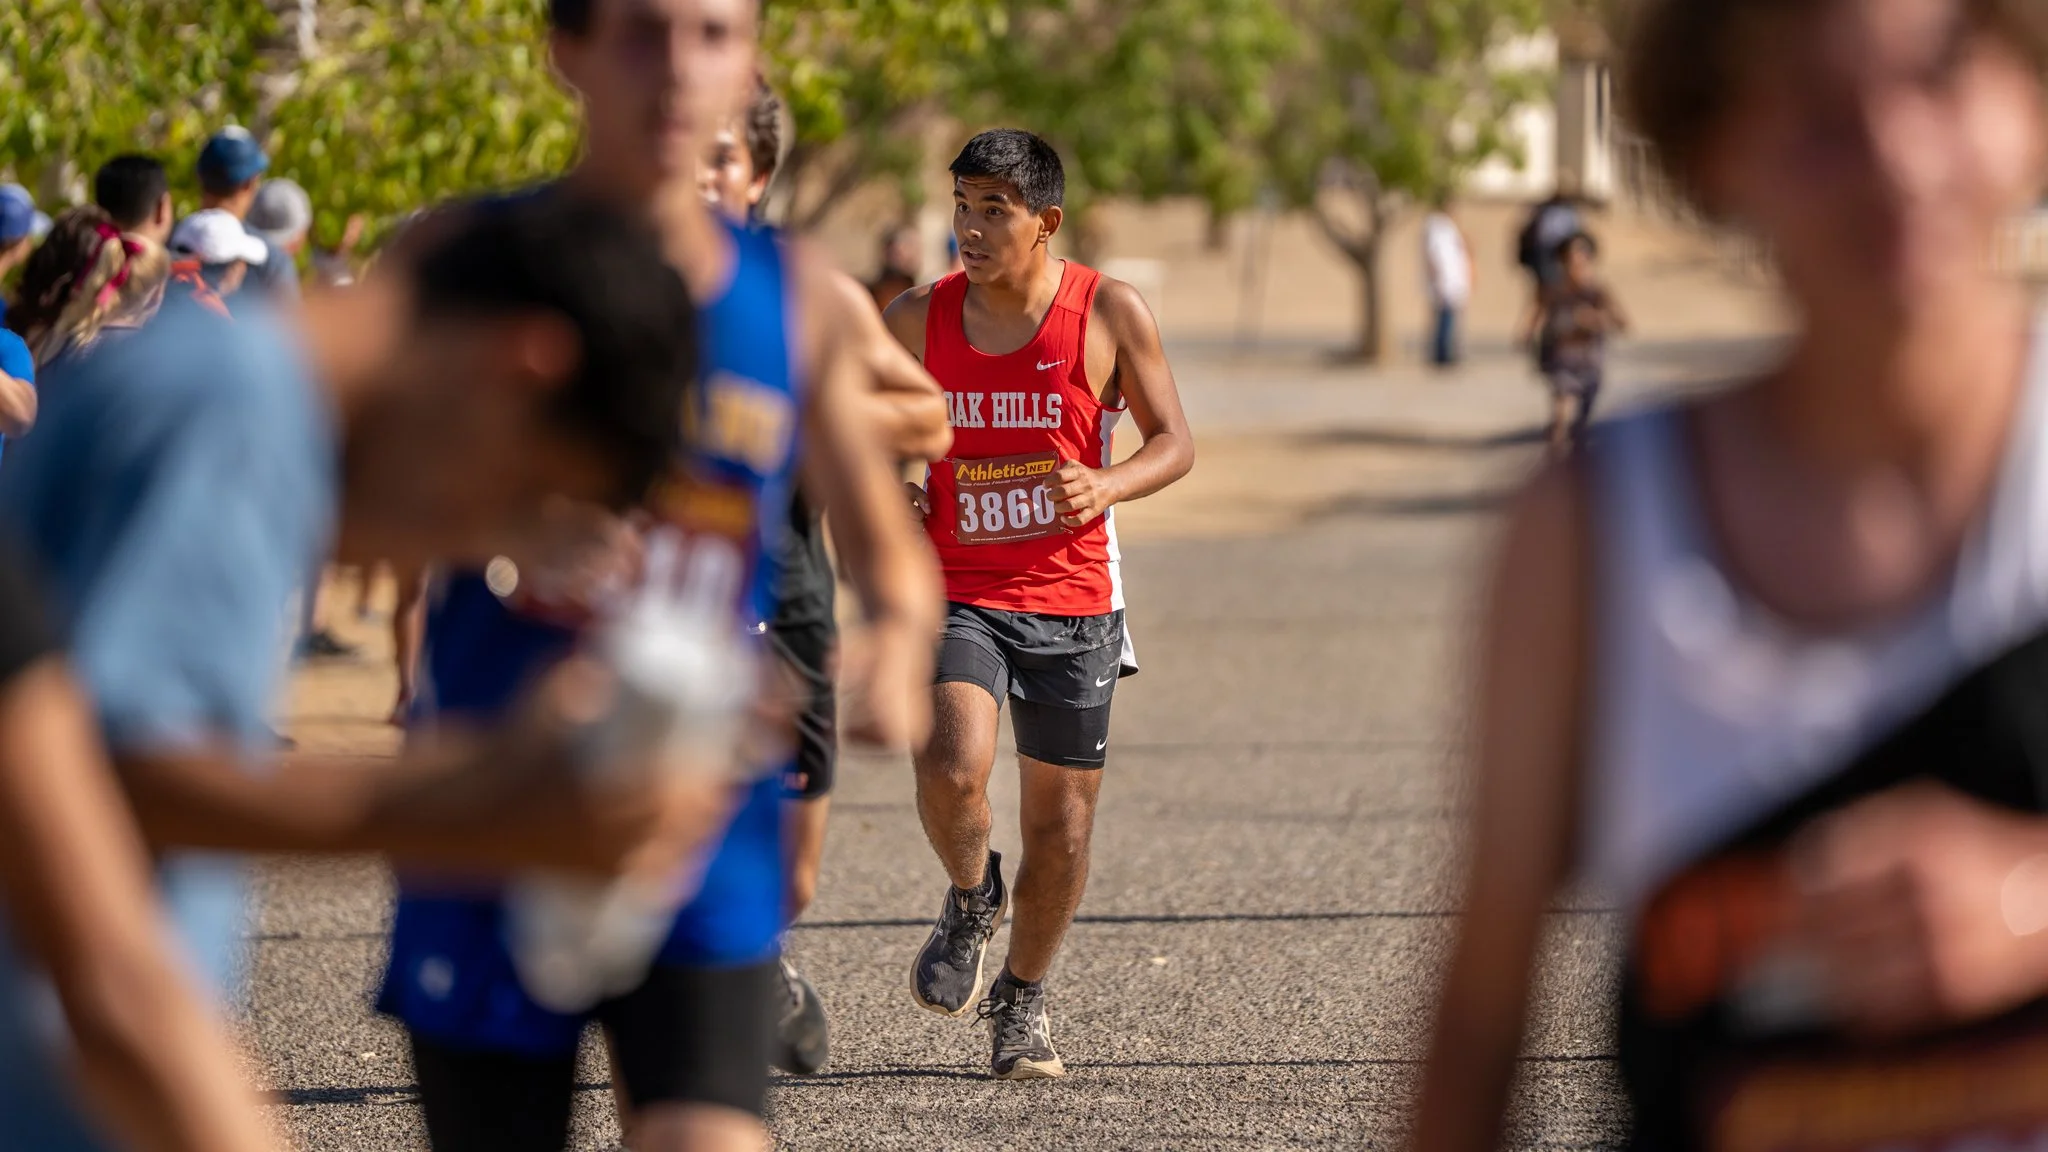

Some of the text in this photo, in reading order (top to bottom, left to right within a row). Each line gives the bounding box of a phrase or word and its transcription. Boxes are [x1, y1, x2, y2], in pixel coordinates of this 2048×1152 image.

[991, 392, 1062, 428] HILLS
[956, 463, 1027, 481] Athletic
[959, 484, 1056, 533] 3860
